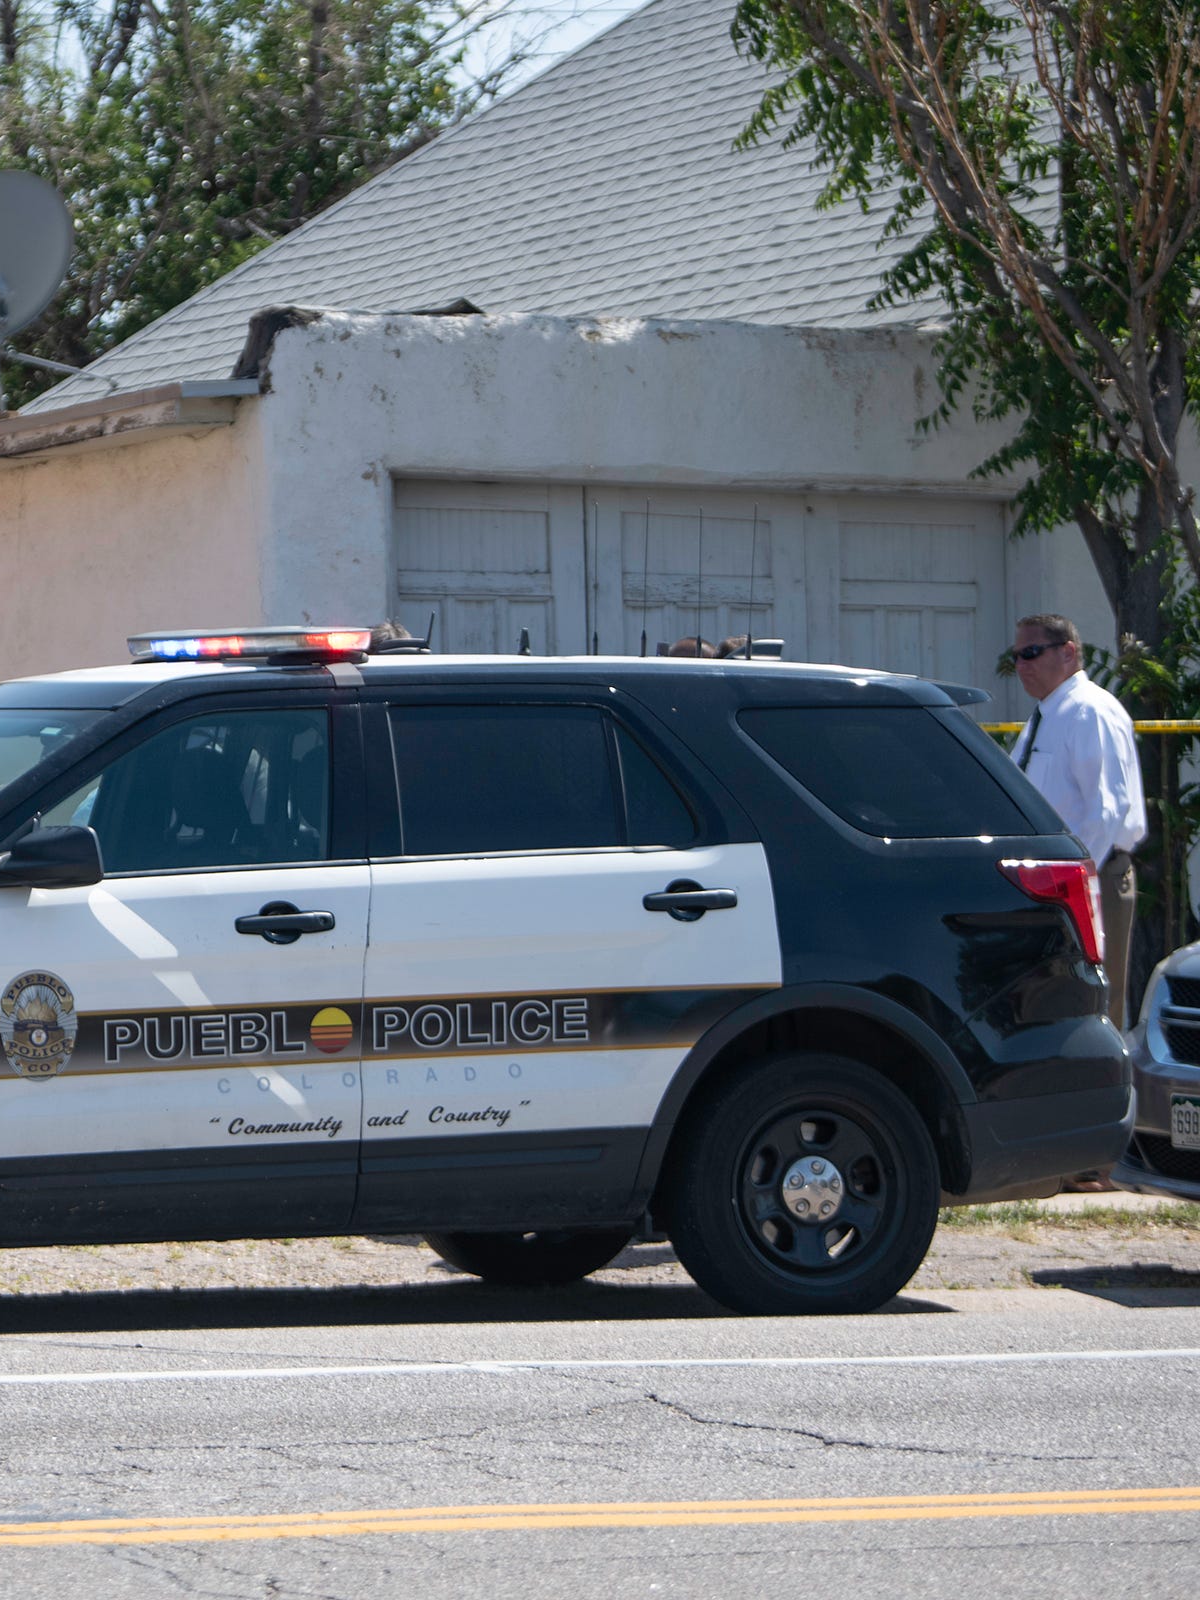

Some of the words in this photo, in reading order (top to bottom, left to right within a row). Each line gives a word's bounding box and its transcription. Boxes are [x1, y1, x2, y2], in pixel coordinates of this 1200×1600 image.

[7, 974, 68, 1001] PUEBLO
[373, 998, 589, 1050] POLICE
[8, 1038, 73, 1057] POLICE
[27, 1063, 51, 1073] CO
[217, 1062, 522, 1094] COLORADO
[367, 1110, 409, 1127] and
